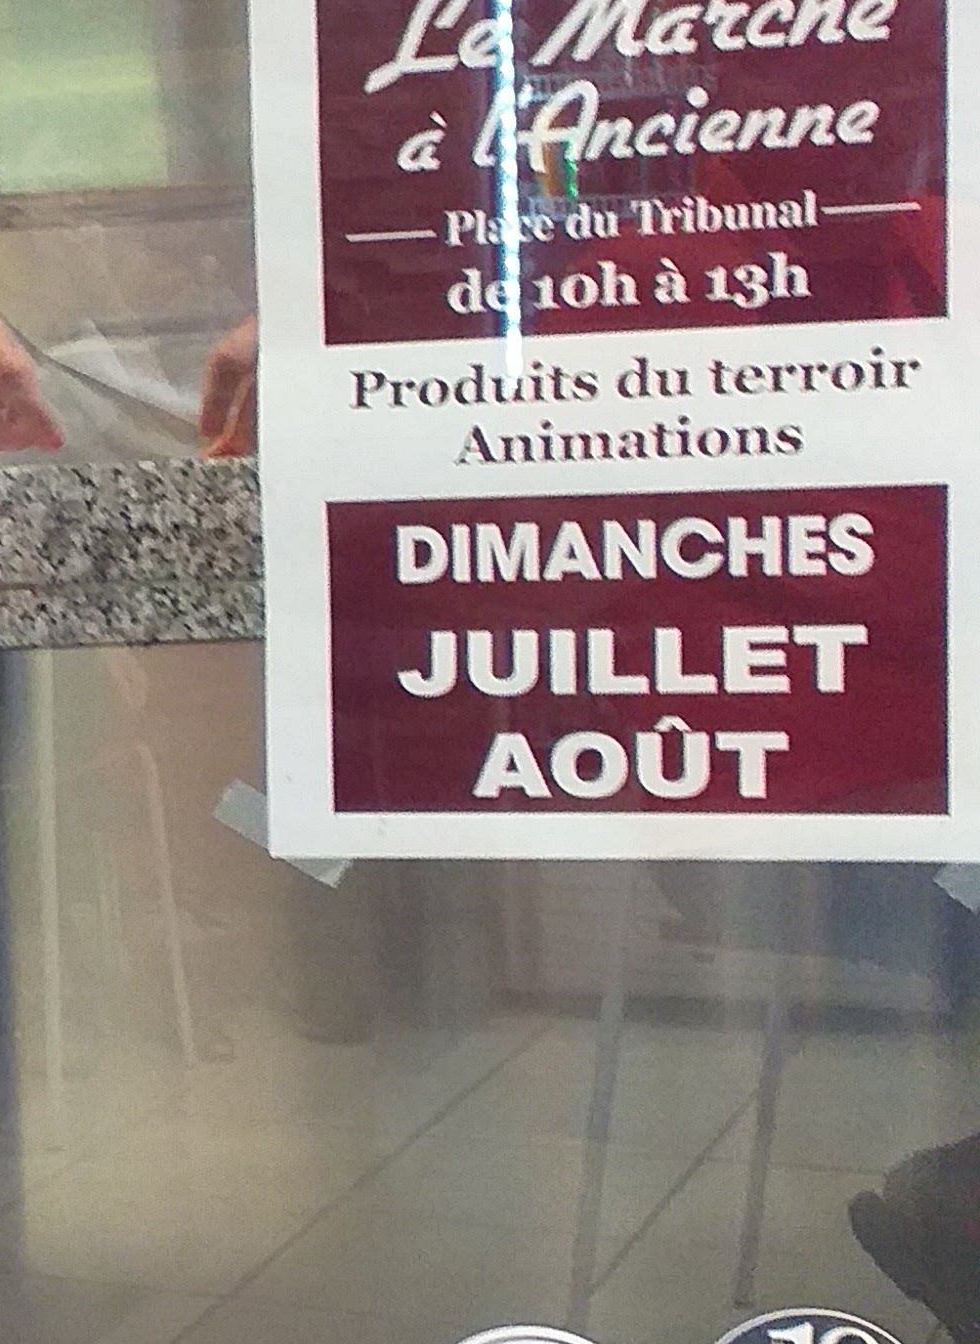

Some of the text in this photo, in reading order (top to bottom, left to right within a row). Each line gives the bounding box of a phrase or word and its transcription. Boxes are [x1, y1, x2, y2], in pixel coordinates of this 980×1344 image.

[397, 79, 880, 174] à l'Ancienne
[443, 191, 819, 249] Place du Tribunal
[447, 252, 812, 316] de 10h à 13h
[349, 346, 923, 411] Produits du terroir
[454, 414, 806, 467] Animations
[394, 513, 876, 586] DIMANCHES
[397, 625, 869, 699] JUILLET
[472, 716, 790, 801] AOÛT
